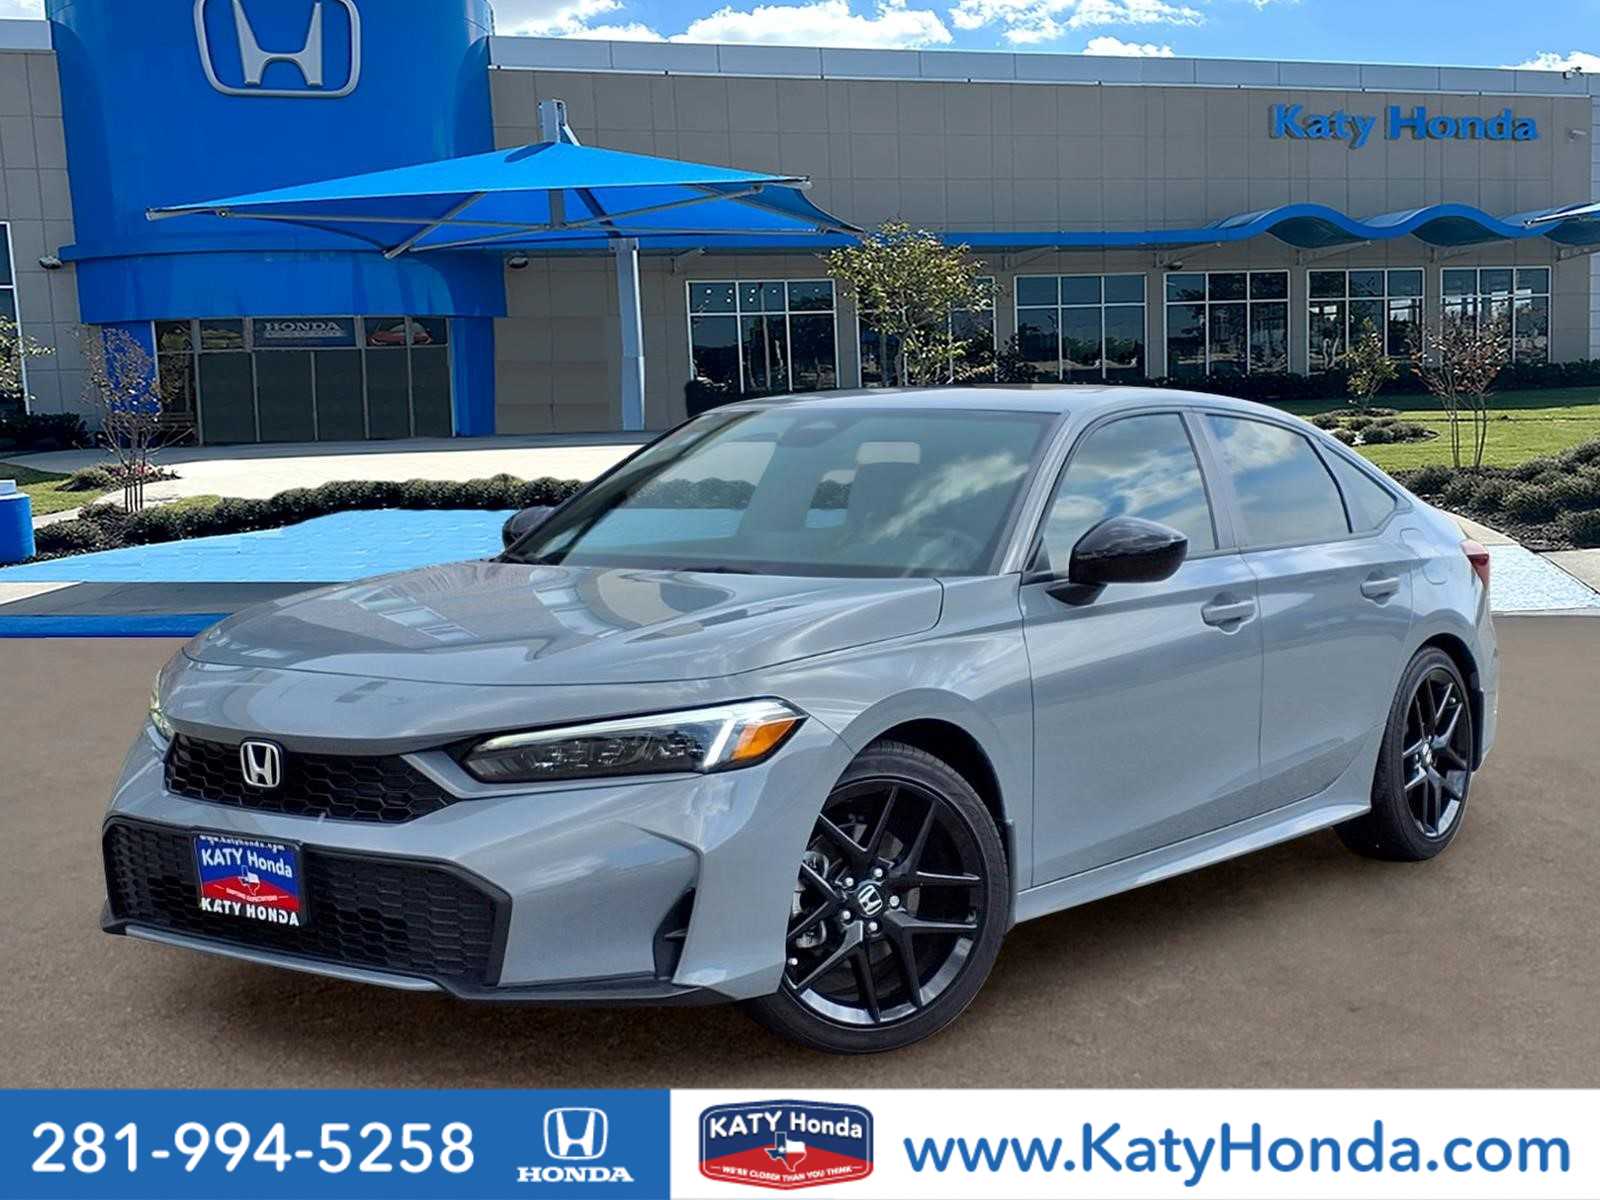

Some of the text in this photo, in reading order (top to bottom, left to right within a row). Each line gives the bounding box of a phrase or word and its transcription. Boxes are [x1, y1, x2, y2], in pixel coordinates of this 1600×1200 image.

[1269, 104, 1540, 149] Katy Honda
[264, 321, 341, 331] HONDA
[201, 848, 293, 878] KATY Honda
[201, 897, 300, 927] KATY HONDA
